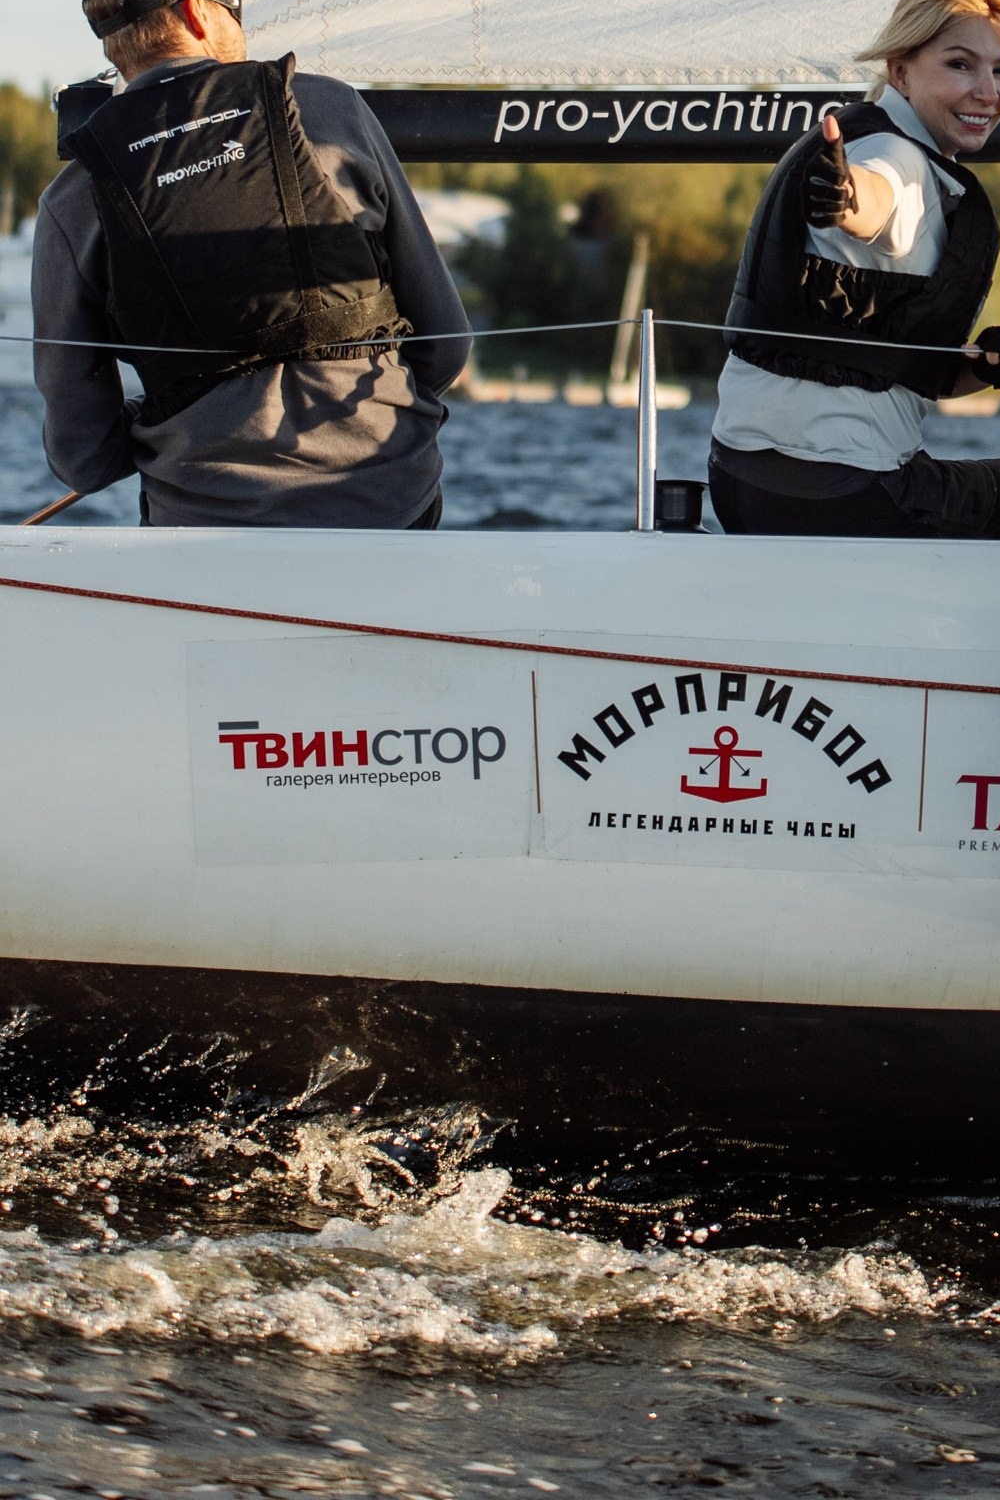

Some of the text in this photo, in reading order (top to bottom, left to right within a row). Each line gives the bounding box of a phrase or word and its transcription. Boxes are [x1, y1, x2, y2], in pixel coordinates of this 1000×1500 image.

[128, 107, 252, 152] MARINEPOOL
[157, 147, 246, 187] PROYACHTING
[556, 671, 893, 794] МОРПРИБОР
[266, 769, 442, 789] галерея интерьеров
[588, 811, 856, 839] ЛЕГЕНДАРНЫЕ ЧАСЫ
